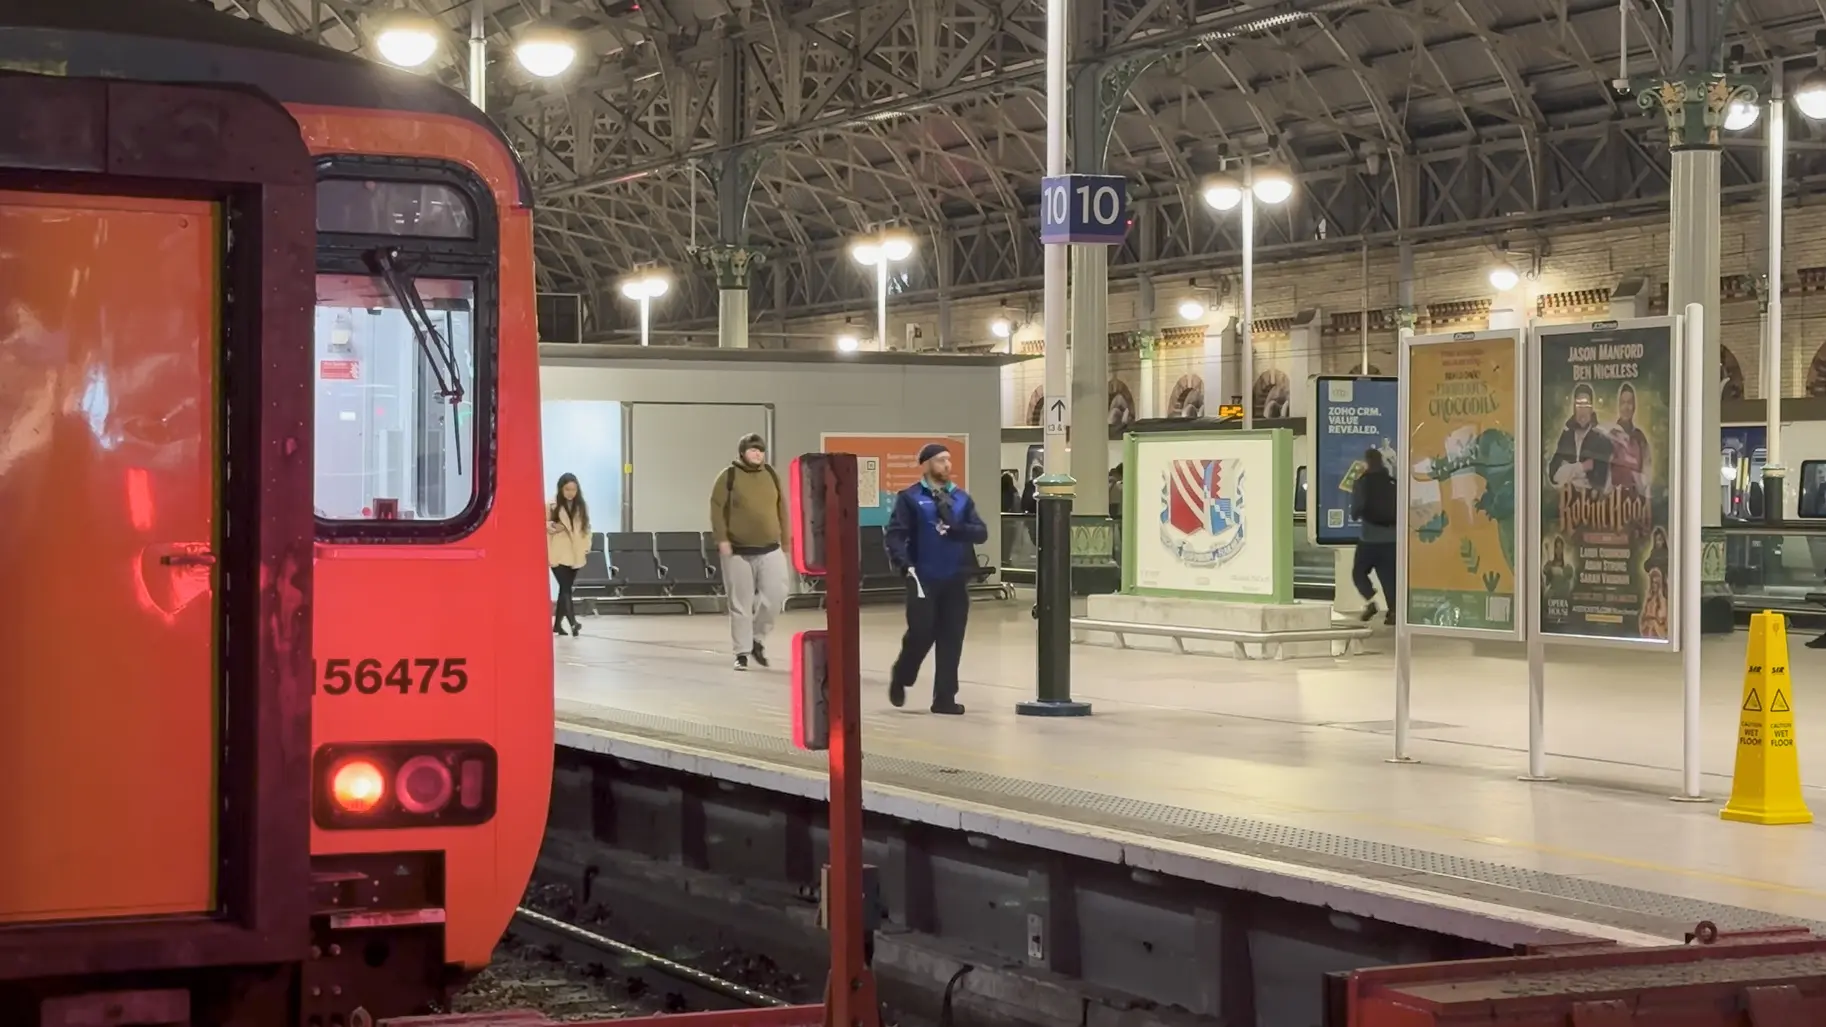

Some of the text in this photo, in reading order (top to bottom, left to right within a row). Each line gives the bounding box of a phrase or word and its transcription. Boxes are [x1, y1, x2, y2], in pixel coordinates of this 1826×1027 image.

[1044, 186, 1067, 225] 10
[1076, 185, 1120, 225] 10
[1567, 343, 1644, 362] JASON MANFORD
[1572, 362, 1639, 381] BEN NICKLESS
[1328, 406, 1382, 417] ZOHO CRM.
[1328, 416, 1359, 425] VALUE
[1328, 425, 1380, 435] REVEALED.
[1559, 482, 1652, 535] Robin Hood
[1547, 598, 1569, 608] OPERA
[1744, 728, 1759, 737] WET
[1774, 729, 1789, 738] WET
[1740, 737, 1762, 746] FLOOR
[1771, 739, 1793, 747] FLOOR
